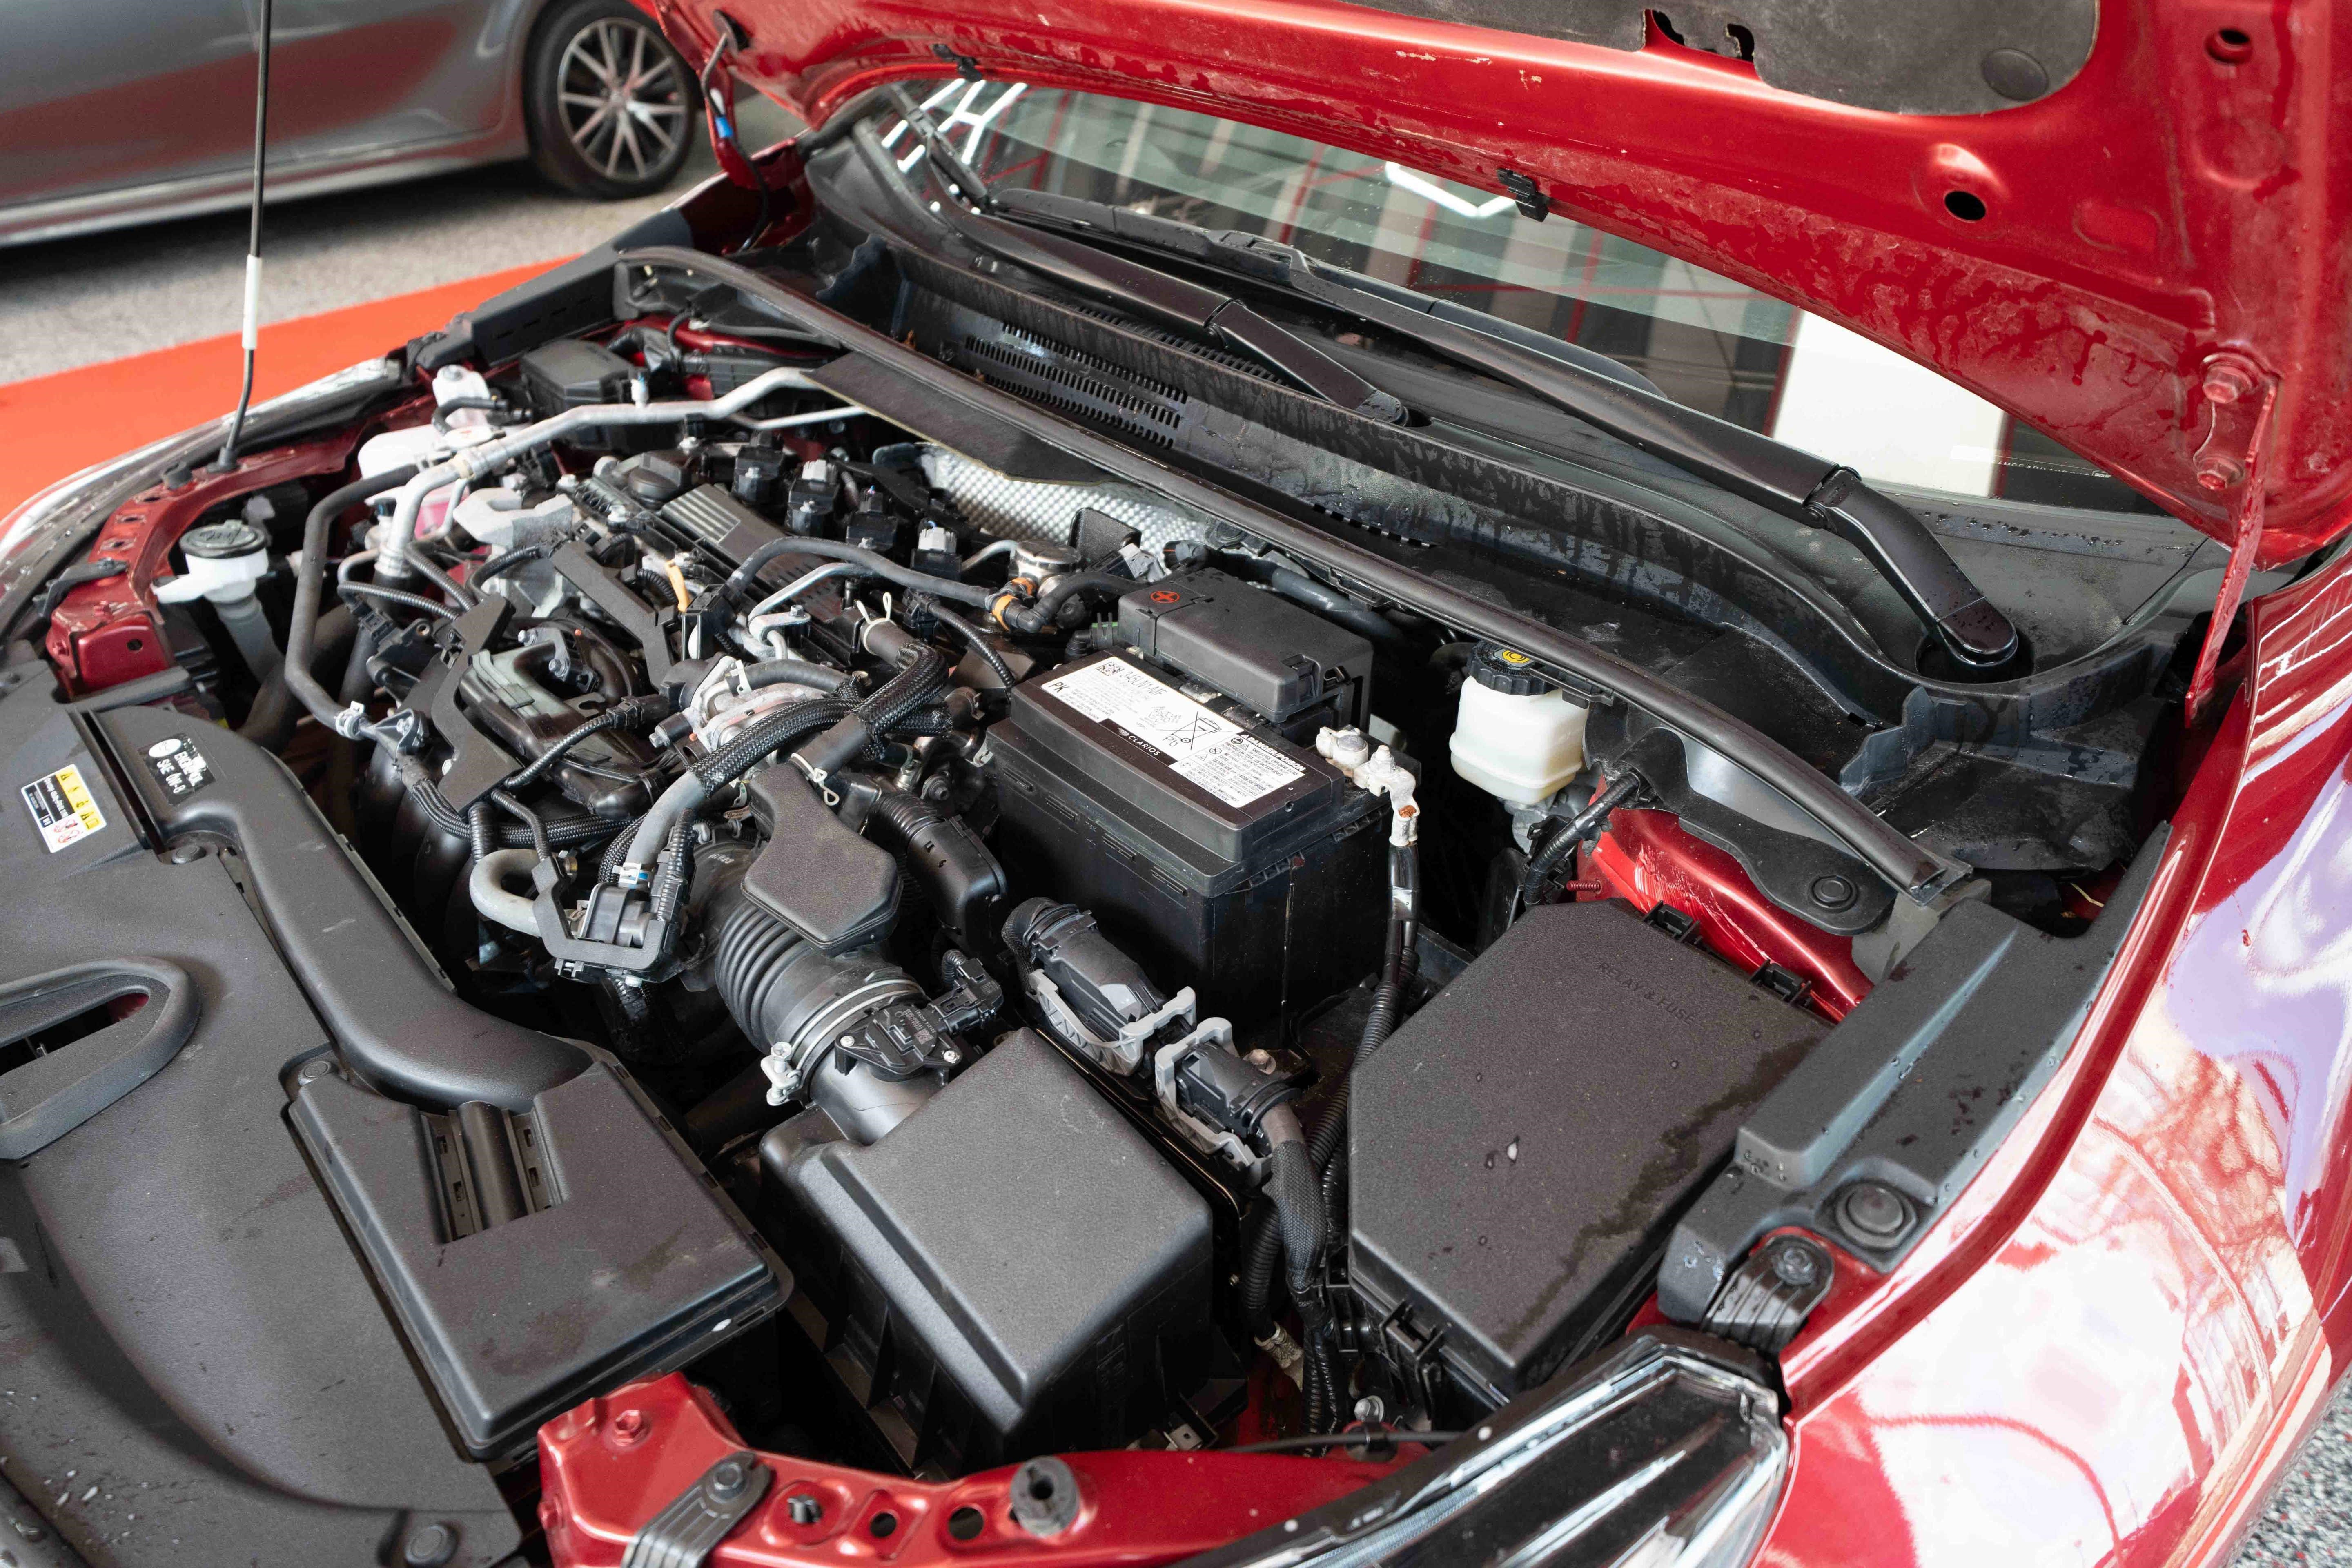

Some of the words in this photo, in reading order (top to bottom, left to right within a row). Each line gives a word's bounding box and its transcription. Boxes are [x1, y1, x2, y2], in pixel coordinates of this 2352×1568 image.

[1048, 682, 1070, 693] PK
[1128, 735, 1161, 755] CLARIOS
[1163, 736, 1178, 747] Pb
[1245, 736, 1307, 771] DANGER/POISON
[1599, 962, 1644, 991] RELAY
[1644, 990, 1656, 1001] &
[1657, 995, 1696, 1025] FUSE
